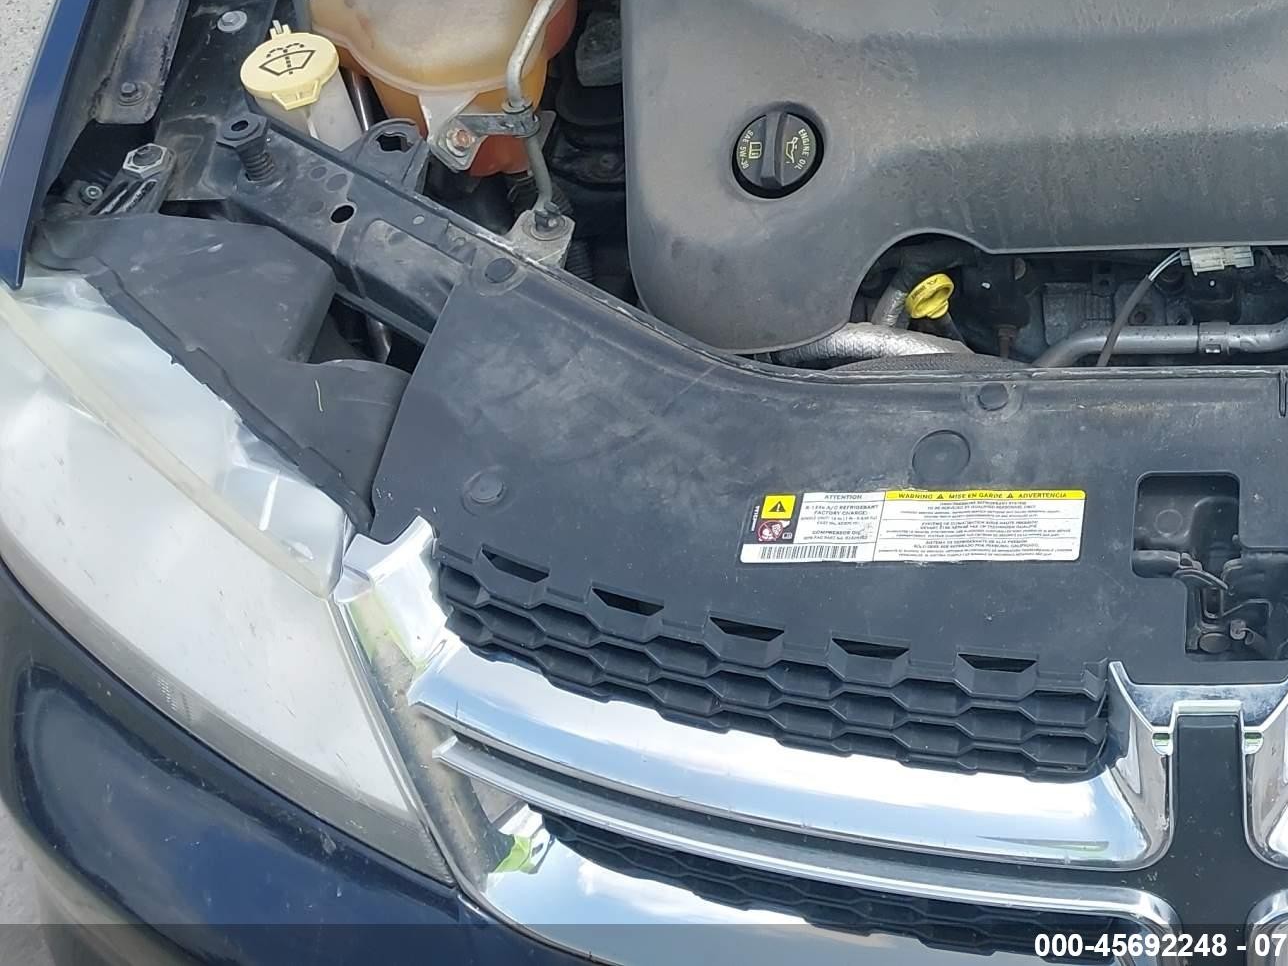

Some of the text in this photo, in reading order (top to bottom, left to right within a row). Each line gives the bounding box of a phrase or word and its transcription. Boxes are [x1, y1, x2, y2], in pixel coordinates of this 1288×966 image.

[742, 129, 753, 143] SAE
[793, 128, 811, 171] ENGINE OIL
[979, 491, 1003, 499] GARDE
[1019, 491, 1068, 499] ADVERTENCIA
